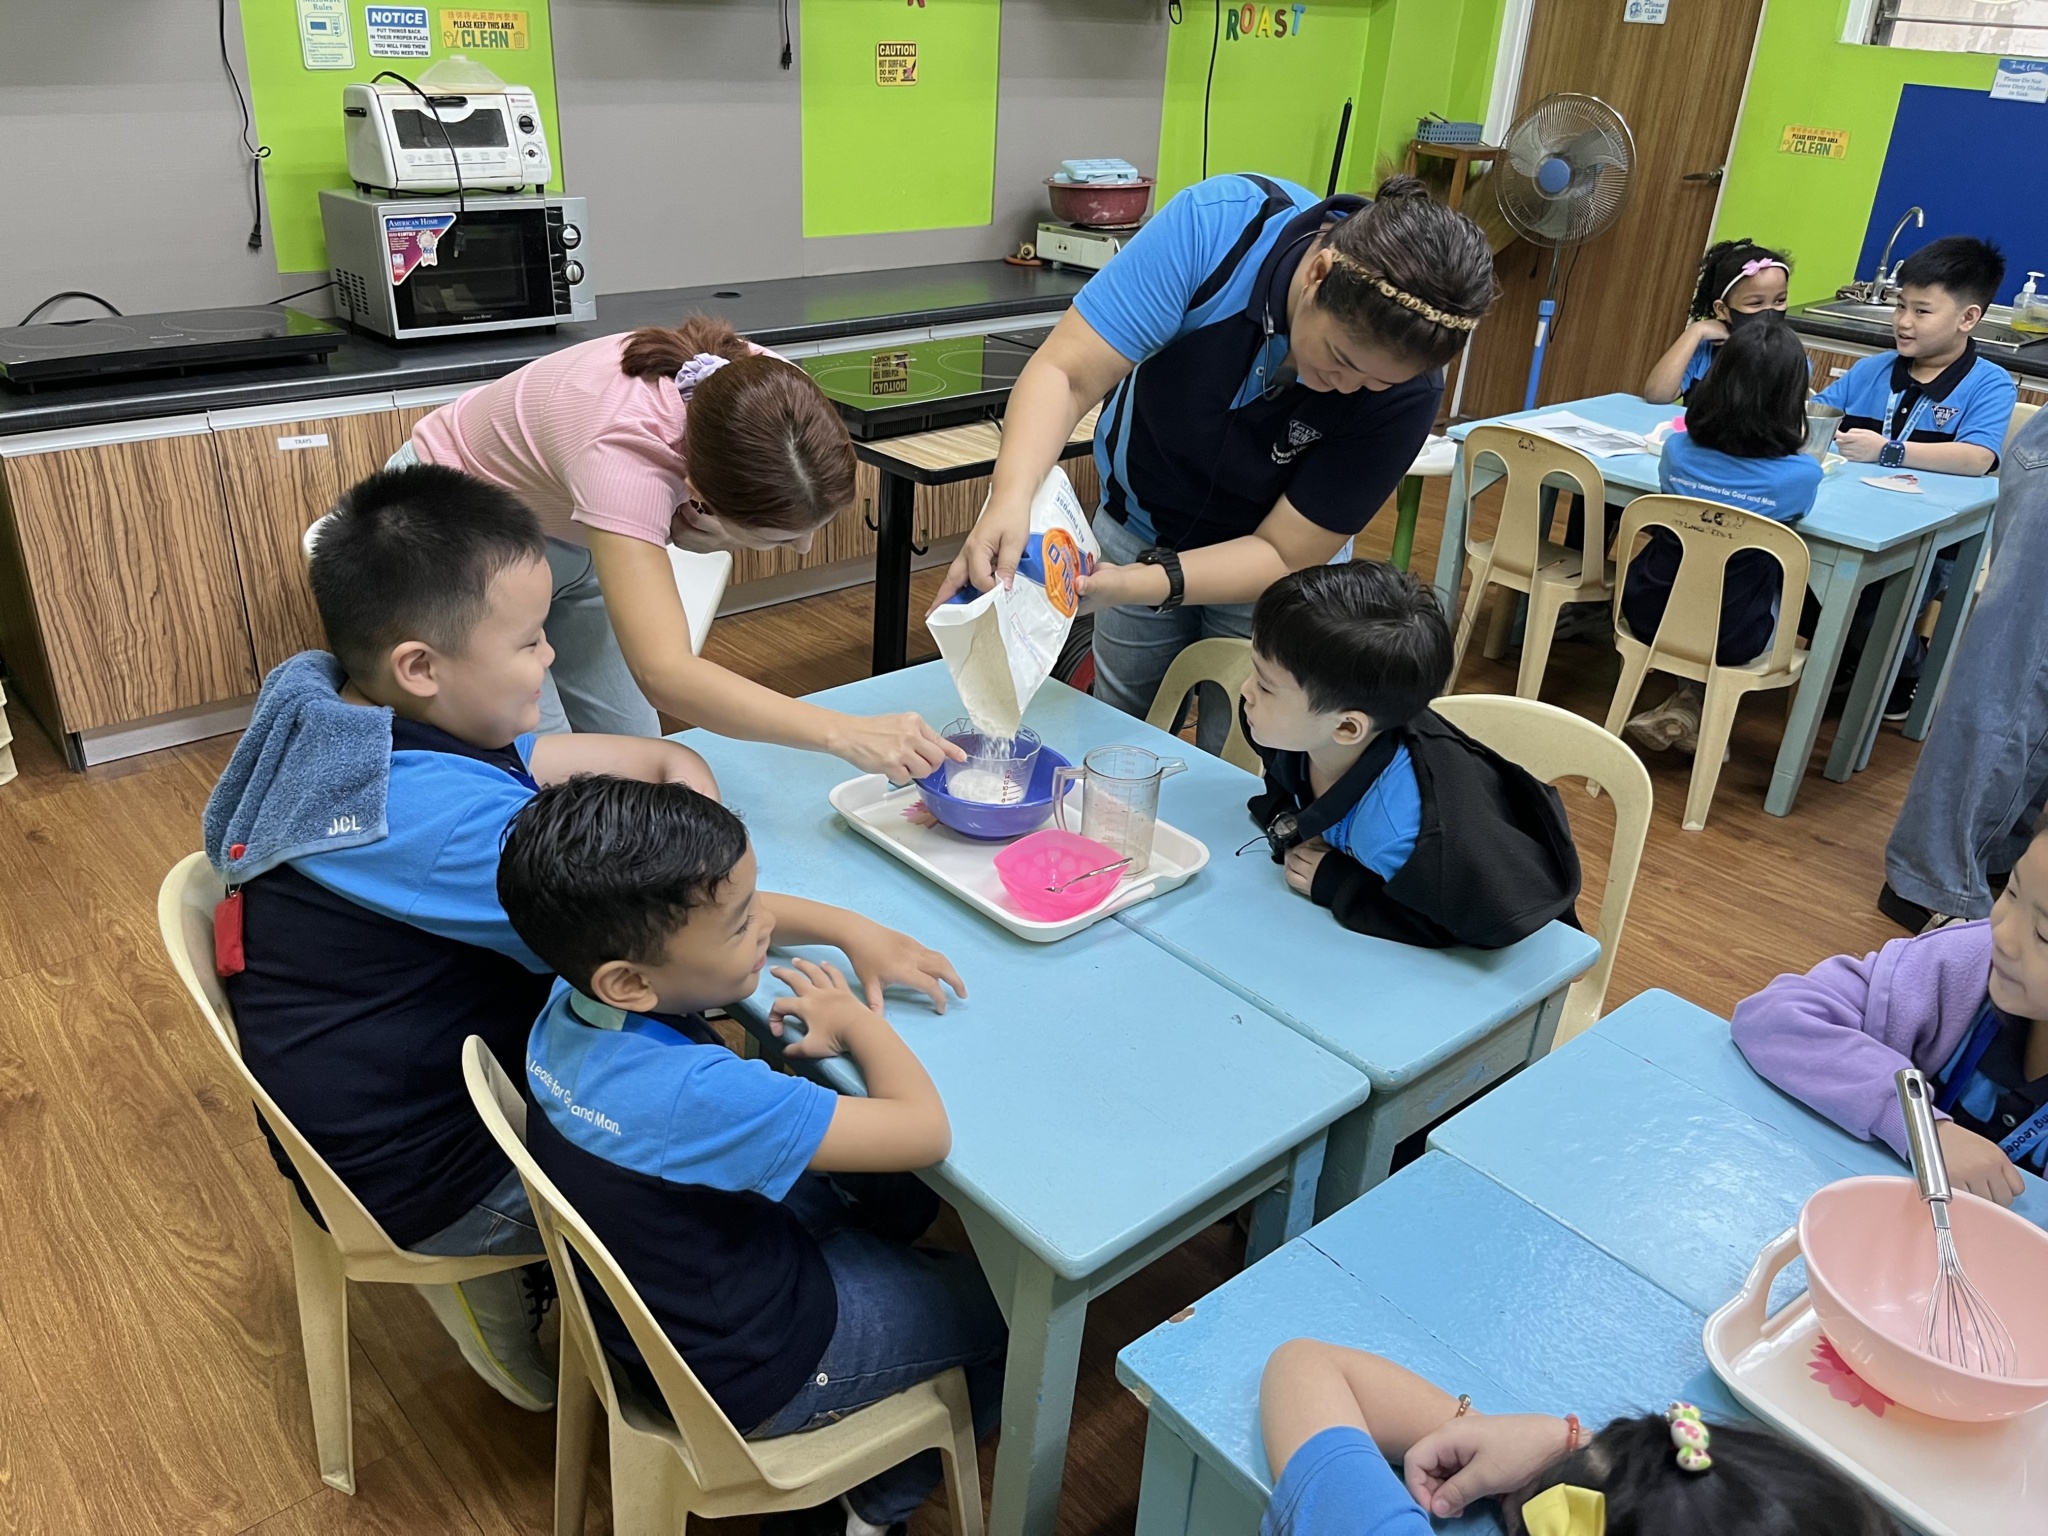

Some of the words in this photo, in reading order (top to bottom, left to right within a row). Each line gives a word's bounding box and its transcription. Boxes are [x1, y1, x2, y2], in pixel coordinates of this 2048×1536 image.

[371, 11, 424, 24] NOTICE
[453, 20, 473, 29] PLEASE
[473, 21, 486, 29] KEEP
[487, 21, 500, 30] THIS
[501, 22, 515, 30] AREA
[1226, 3, 1306, 41] ROAST
[461, 29, 510, 48] CLEAN
[880, 45, 915, 55] CAUTION
[888, 59, 908, 68] SURFACE
[1794, 140, 1831, 155] CLEAN
[388, 219, 420, 228] AMERICAN
[420, 218, 439, 226] HOME
[1669, 475, 1697, 488] Developing
[1698, 482, 1722, 494] Leaders
[1721, 487, 1732, 496] for
[1731, 490, 1747, 500] God
[1747, 494, 1761, 503] and
[1760, 496, 1777, 507] Man.
[1055, 495, 1080, 531] PURPOSE
[1048, 543, 1075, 609] GOLD
[328, 814, 362, 836] JCL
[551, 1080, 565, 1099] for
[571, 1105, 595, 1123] and
[593, 1113, 622, 1136] Man.
